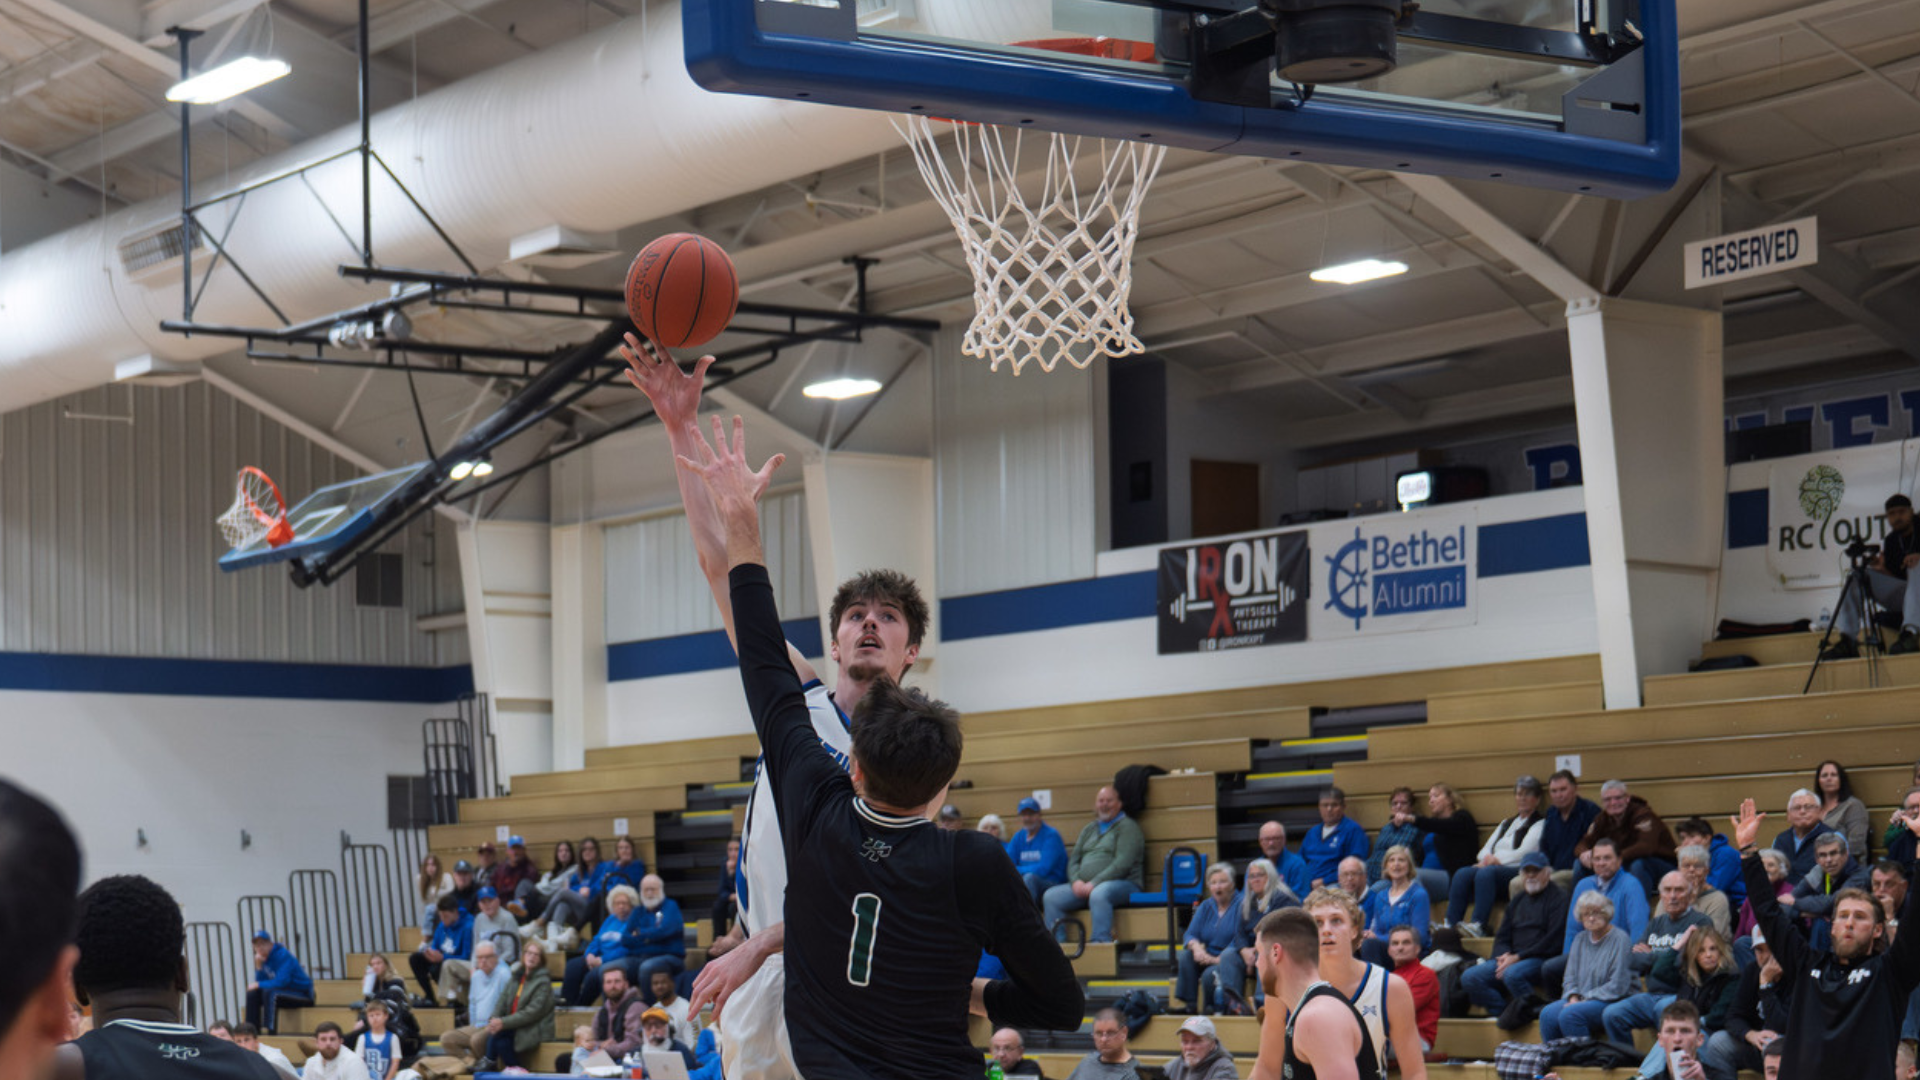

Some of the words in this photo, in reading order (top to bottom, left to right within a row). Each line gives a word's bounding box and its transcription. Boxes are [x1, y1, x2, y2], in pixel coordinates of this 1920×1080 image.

[1701, 227, 1800, 279] RESERVED
[1186, 536, 1279, 601] IRON
[1371, 525, 1466, 571] Bethel
[1233, 604, 1278, 619] PHYSICAL
[1374, 573, 1463, 610] Alumni
[1235, 616, 1277, 632] THERAPY
[847, 892, 883, 987] 1
